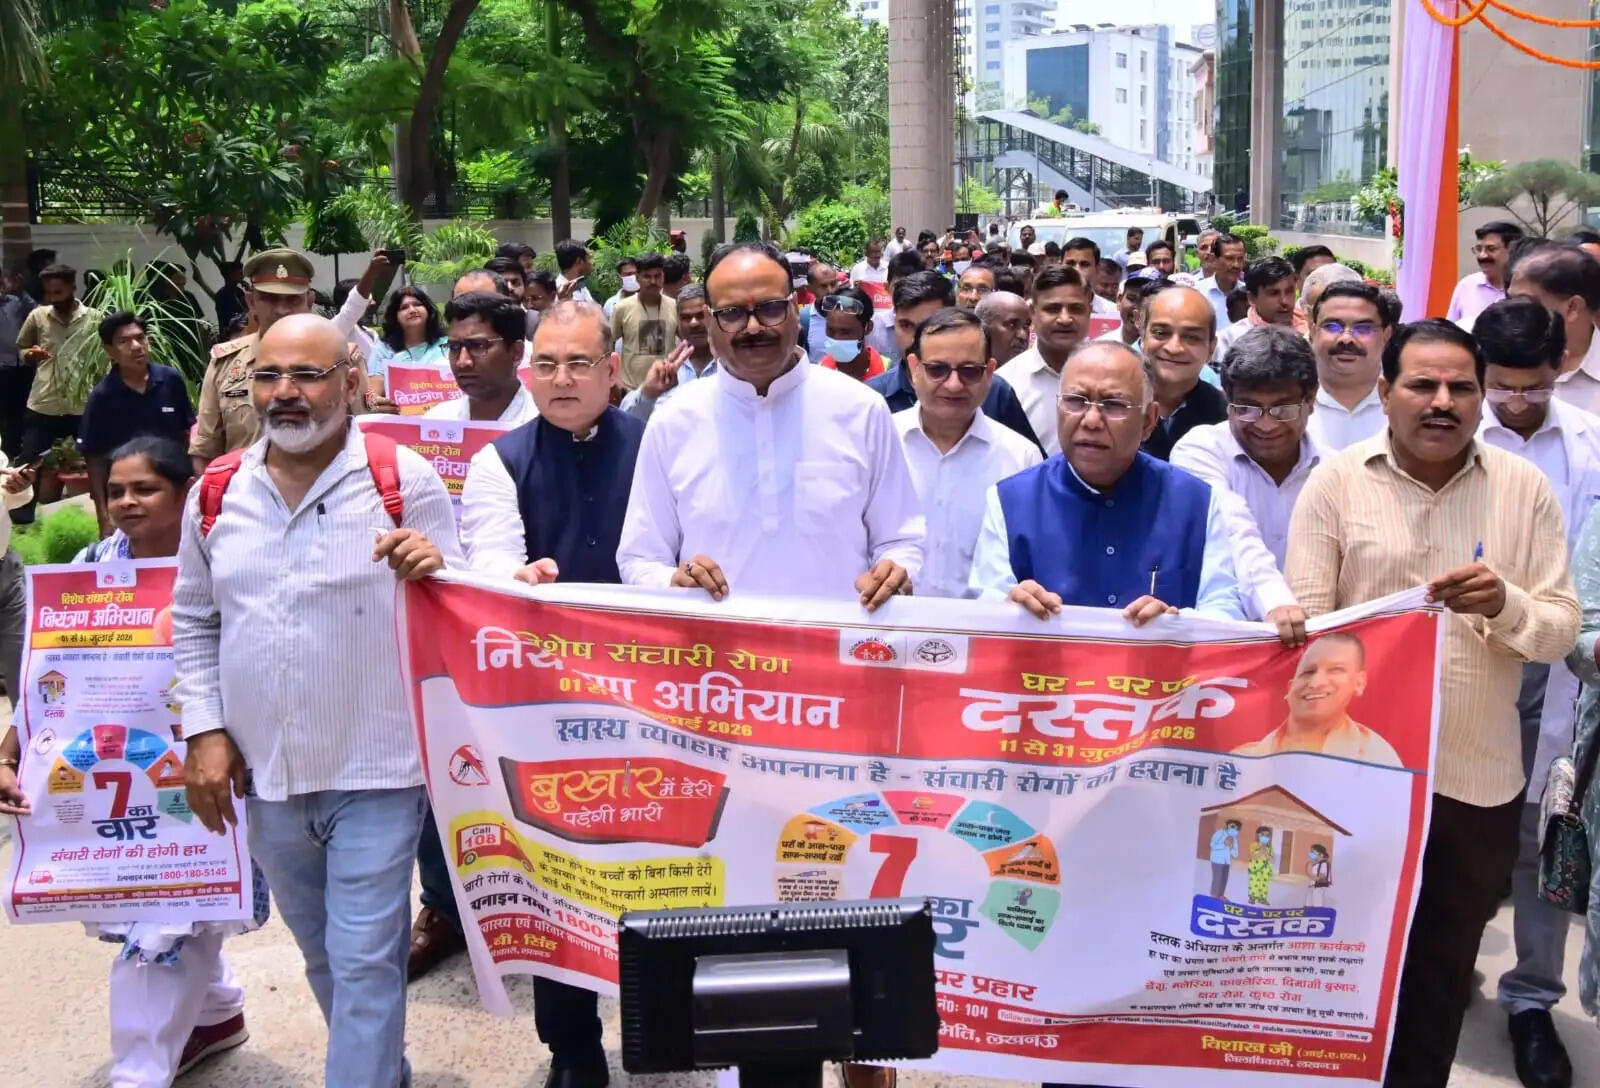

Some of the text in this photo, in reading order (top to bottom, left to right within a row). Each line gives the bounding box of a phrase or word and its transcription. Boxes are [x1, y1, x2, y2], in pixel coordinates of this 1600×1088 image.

[39, 603, 155, 629] नियंत्रण अभियान
[515, 631, 793, 674] िशेष संचारी रोग
[1022, 672, 1069, 692] घर
[1106, 675, 1156, 696] घर
[559, 677, 753, 737] 01 2026
[653, 671, 845, 730] अभियान
[959, 676, 1248, 740] दस्तक
[1000, 738, 1017, 753] 11
[1023, 738, 1049, 757] से
[1053, 741, 1074, 759] 31
[1151, 725, 1196, 741] 2026
[555, 717, 630, 743] स्वस्थ
[637, 721, 732, 761] व्यवहार
[741, 752, 859, 783] अपनाना
[868, 760, 891, 783] है
[923, 766, 1008, 792] संचारी
[1017, 770, 1081, 796] रोगों
[1128, 759, 1209, 787] हराना
[1217, 761, 1241, 792] है
[93, 772, 132, 818] 7
[128, 805, 153, 816] का
[529, 760, 714, 813] बुखार में देरी
[92, 815, 160, 840] वार
[563, 802, 664, 829] पड़ेगी भारी
[465, 834, 497, 849] 108
[472, 827, 491, 835] Call
[51, 842, 208, 861] संचारी रोगों की होगी हार
[160, 867, 227, 880] 1800-180-5145
[628, 865, 641, 881] को
[645, 864, 666, 880] बिना
[669, 863, 693, 877] किसी
[696, 862, 712, 876] देरी
[869, 833, 918, 899] 7
[927, 896, 974, 919] का
[487, 871, 510, 886] रोगों
[512, 873, 526, 887] के
[584, 910, 617, 930] जानका
[522, 894, 551, 917] नम्बर
[610, 886, 645, 901] सरकारी
[1197, 906, 1331, 938] दस्तक
[1224, 903, 1305, 918] घर घर पर
[516, 915, 531, 929] एवं
[535, 920, 564, 939] परिवार
[1150, 930, 1181, 948] दस्तक
[1185, 939, 1228, 953] अभियान
[1232, 942, 1243, 952] के
[971, 975, 1038, 1001] प्रहार
[1283, 976, 1321, 990] दिमागी
[1280, 991, 1304, 1002] रोग
[965, 1003, 988, 1018] 104
[939, 1020, 1060, 1049] मिति, लखनऊ
[1201, 1035, 1265, 1054] विशाख
[1269, 1040, 1295, 1056] जी
[1296, 1060, 1341, 1071] लखनऊ
